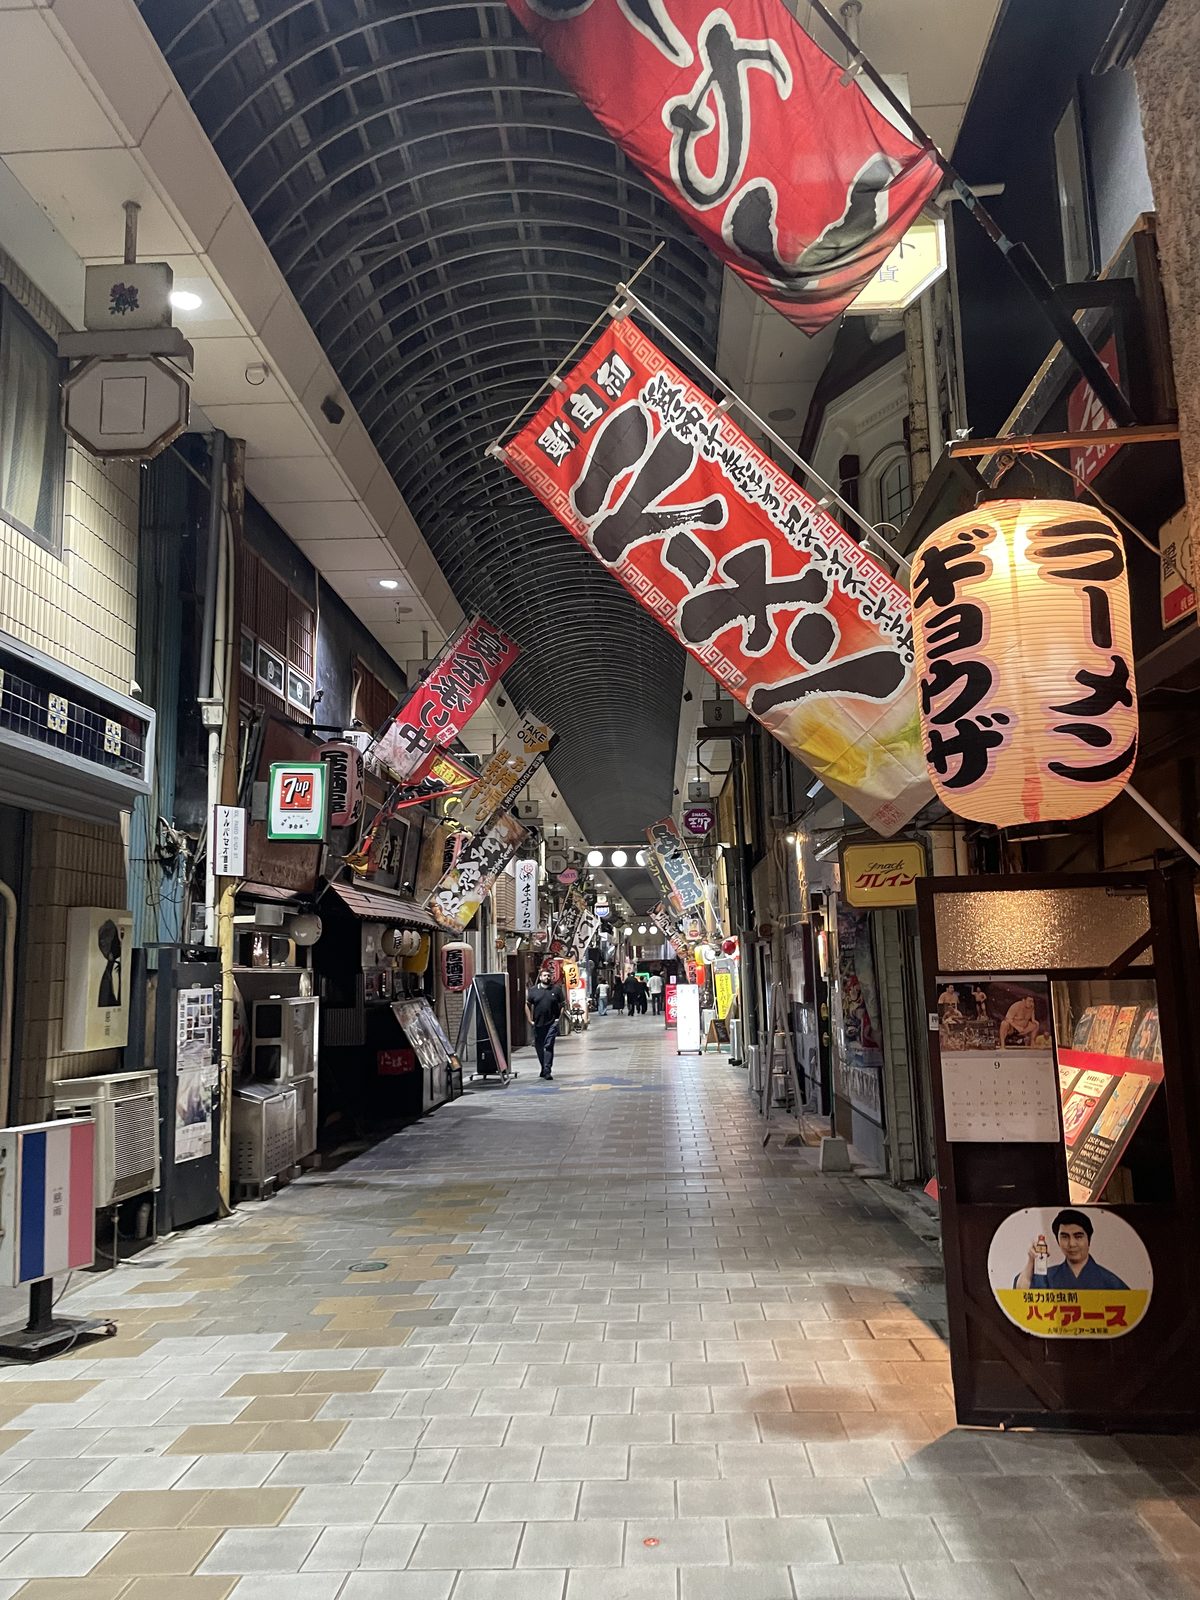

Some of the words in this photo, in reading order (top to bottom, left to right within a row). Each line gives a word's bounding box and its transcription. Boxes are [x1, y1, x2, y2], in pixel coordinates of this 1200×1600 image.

[913, 527, 1010, 789] ギョウザ
[1034, 519, 1138, 783] ラーメン
[517, 730, 538, 749] OUT
[521, 719, 547, 744] TAKE
[855, 873, 917, 889] クレイン
[994, 1061, 1001, 1069] 9
[1023, 1292, 1078, 1304] 強力殺虫剤
[1026, 1305, 1128, 1327] ハイアース
